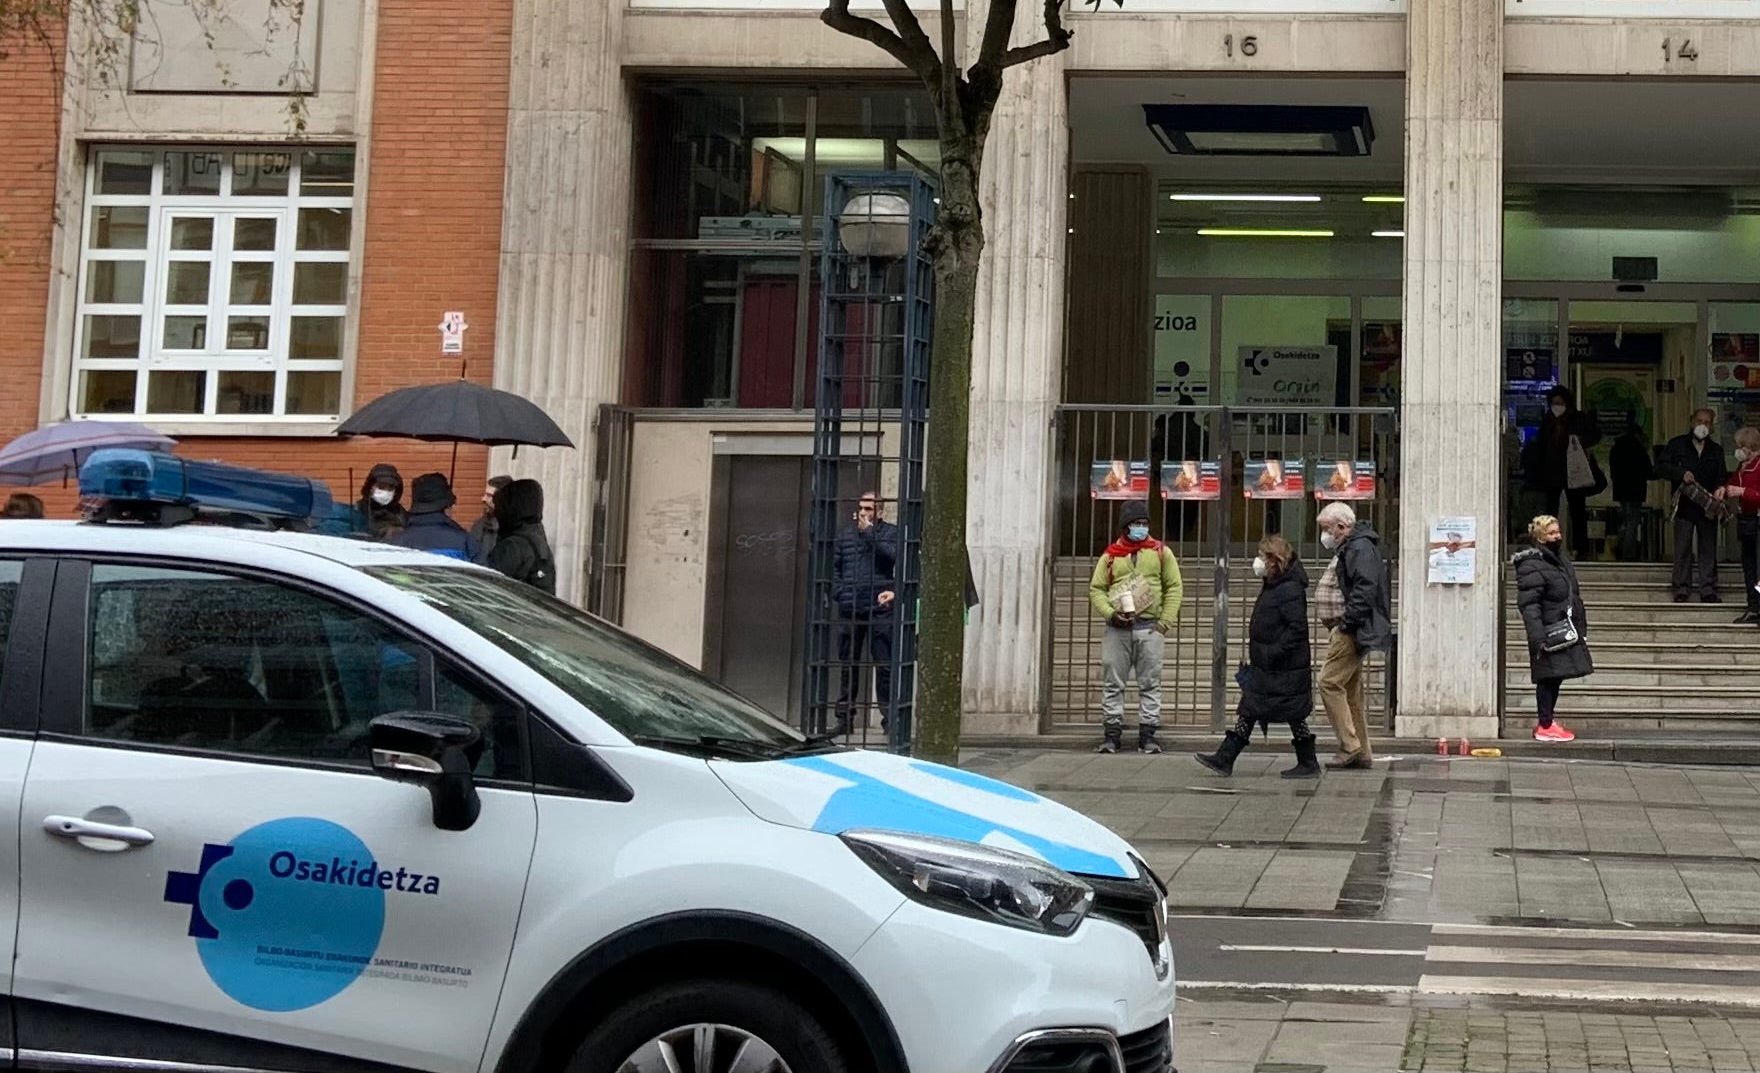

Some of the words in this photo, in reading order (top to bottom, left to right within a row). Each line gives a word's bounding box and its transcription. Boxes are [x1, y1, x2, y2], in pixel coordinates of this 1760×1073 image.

[1223, 34, 1258, 58] 16
[1661, 37, 1699, 63] 14
[269, 851, 441, 895] Osakidetza
[256, 944, 324, 961] BILBO-BASURTU
[374, 957, 418, 972] SANITARIO
[420, 962, 472, 977] INTEGRATUA
